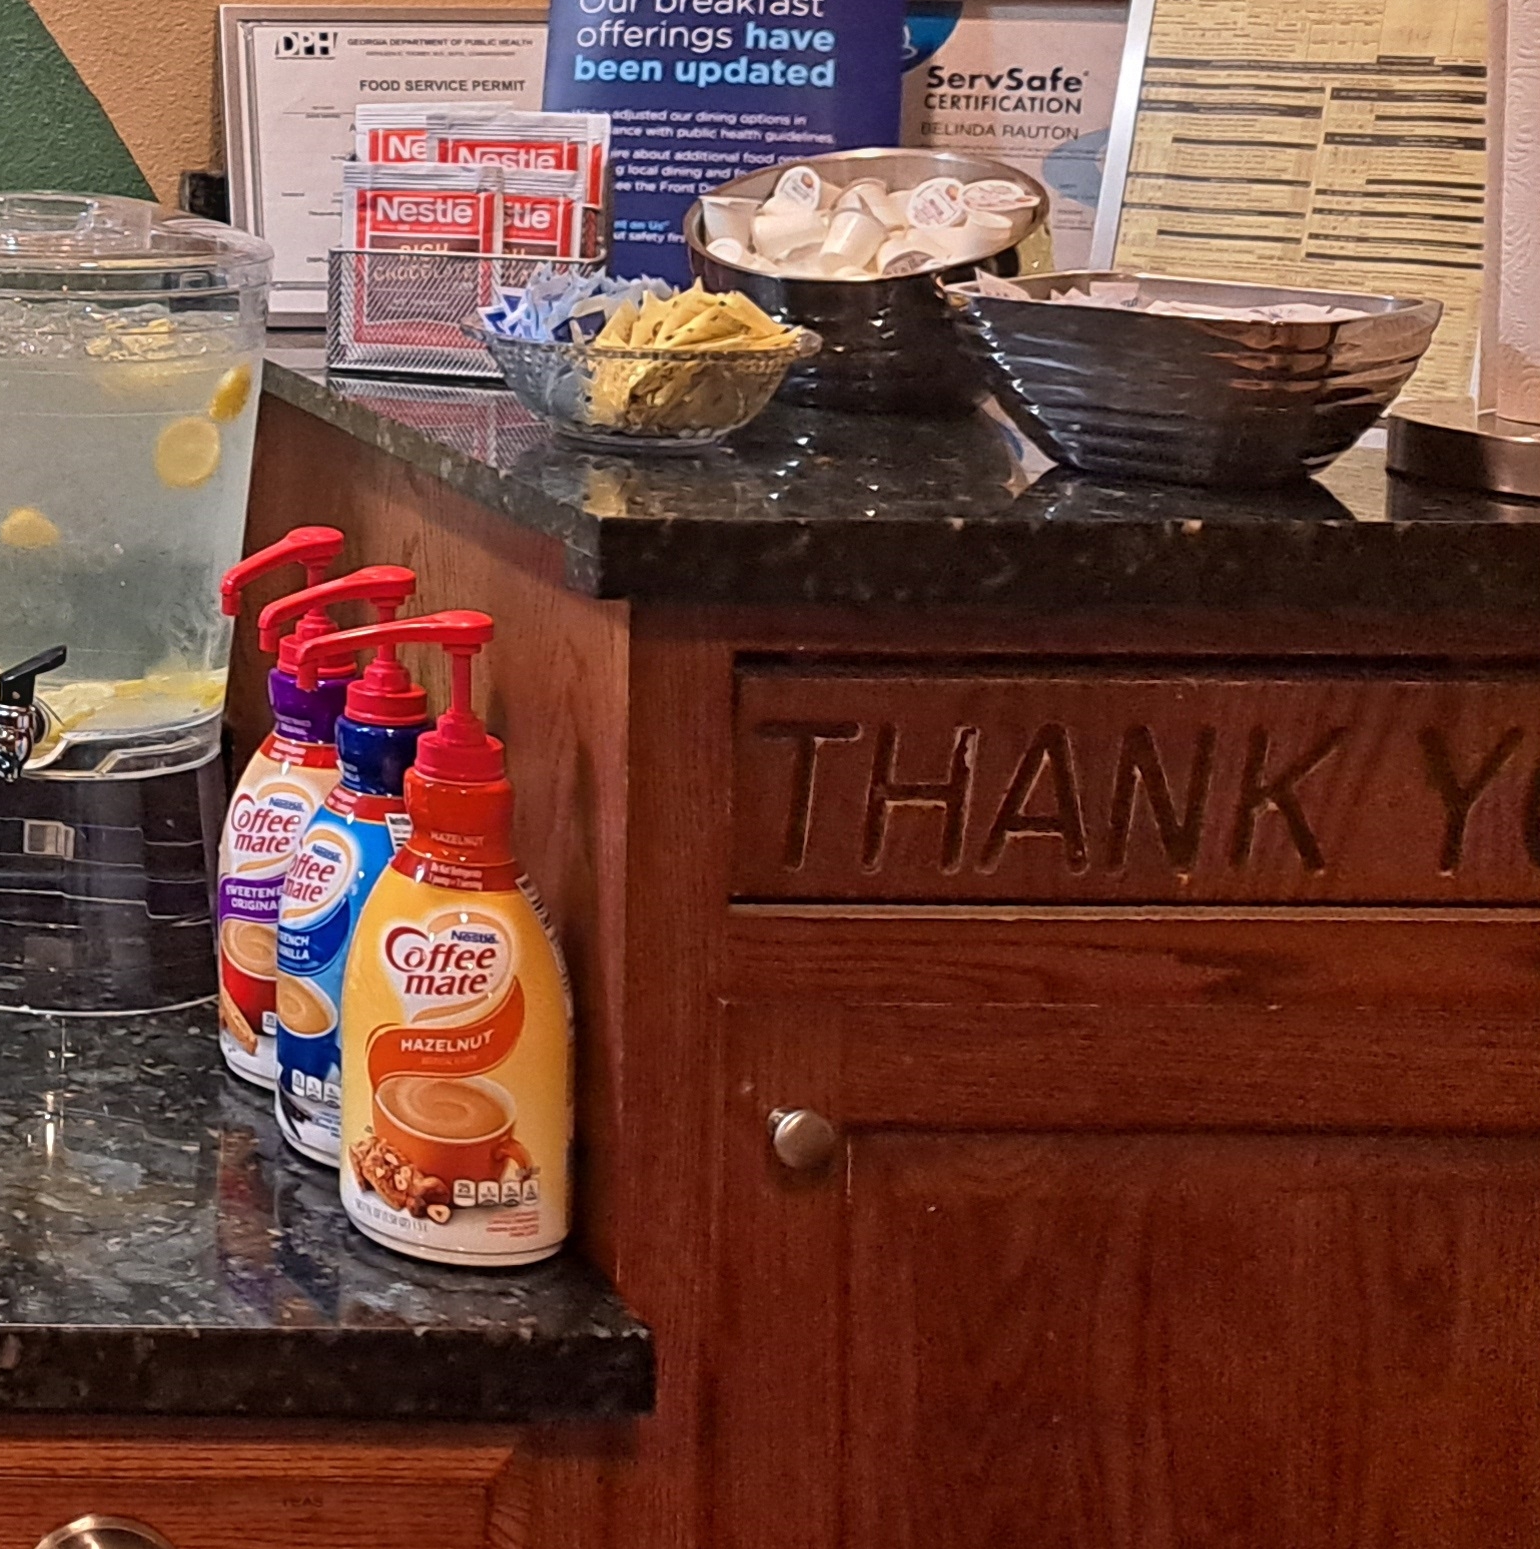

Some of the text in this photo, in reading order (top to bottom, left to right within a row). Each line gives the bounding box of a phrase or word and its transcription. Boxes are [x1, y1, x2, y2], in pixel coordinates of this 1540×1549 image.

[275, 31, 340, 57] DPH
[389, 39, 449, 47] DEPARTMENT
[451, 39, 463, 47] OF
[465, 39, 497, 47] PUBLIC
[498, 39, 533, 47] HEALTH
[576, 20, 836, 54] offerings have
[574, 54, 836, 89] been updated
[926, 65, 1083, 93] ServSafe
[359, 79, 526, 92] FOOD SERVICE PERMIT
[923, 93, 1082, 115] CERTIFICATION
[612, 109, 667, 122] adjusted
[670, 111, 693, 122] our
[695, 112, 737, 126] dining
[739, 113, 791, 127] options
[793, 114, 807, 125] in
[645, 127, 673, 138] with
[676, 128, 717, 140] public
[720, 129, 762, 140] health
[632, 148, 671, 160] about
[674, 149, 740, 163] additional
[743, 151, 774, 164] food
[627, 163, 659, 176] local
[661, 165, 703, 180] dining
[705, 167, 731, 179] and
[634, 179, 695, 194] the Front
[628, 231, 665, 244] safety
[756, 720, 1347, 876] THANK
[231, 793, 302, 833] Coffee
[234, 833, 291, 853] mate
[430, 831, 484, 846] HAZELNUT
[288, 853, 335, 883] offee
[225, 884, 283, 899] SWEETENE
[231, 897, 278, 911] ORIGINA
[385, 926, 496, 973] Coffee
[404, 974, 488, 996] mate
[401, 1029, 496, 1053] HAZELNUT
